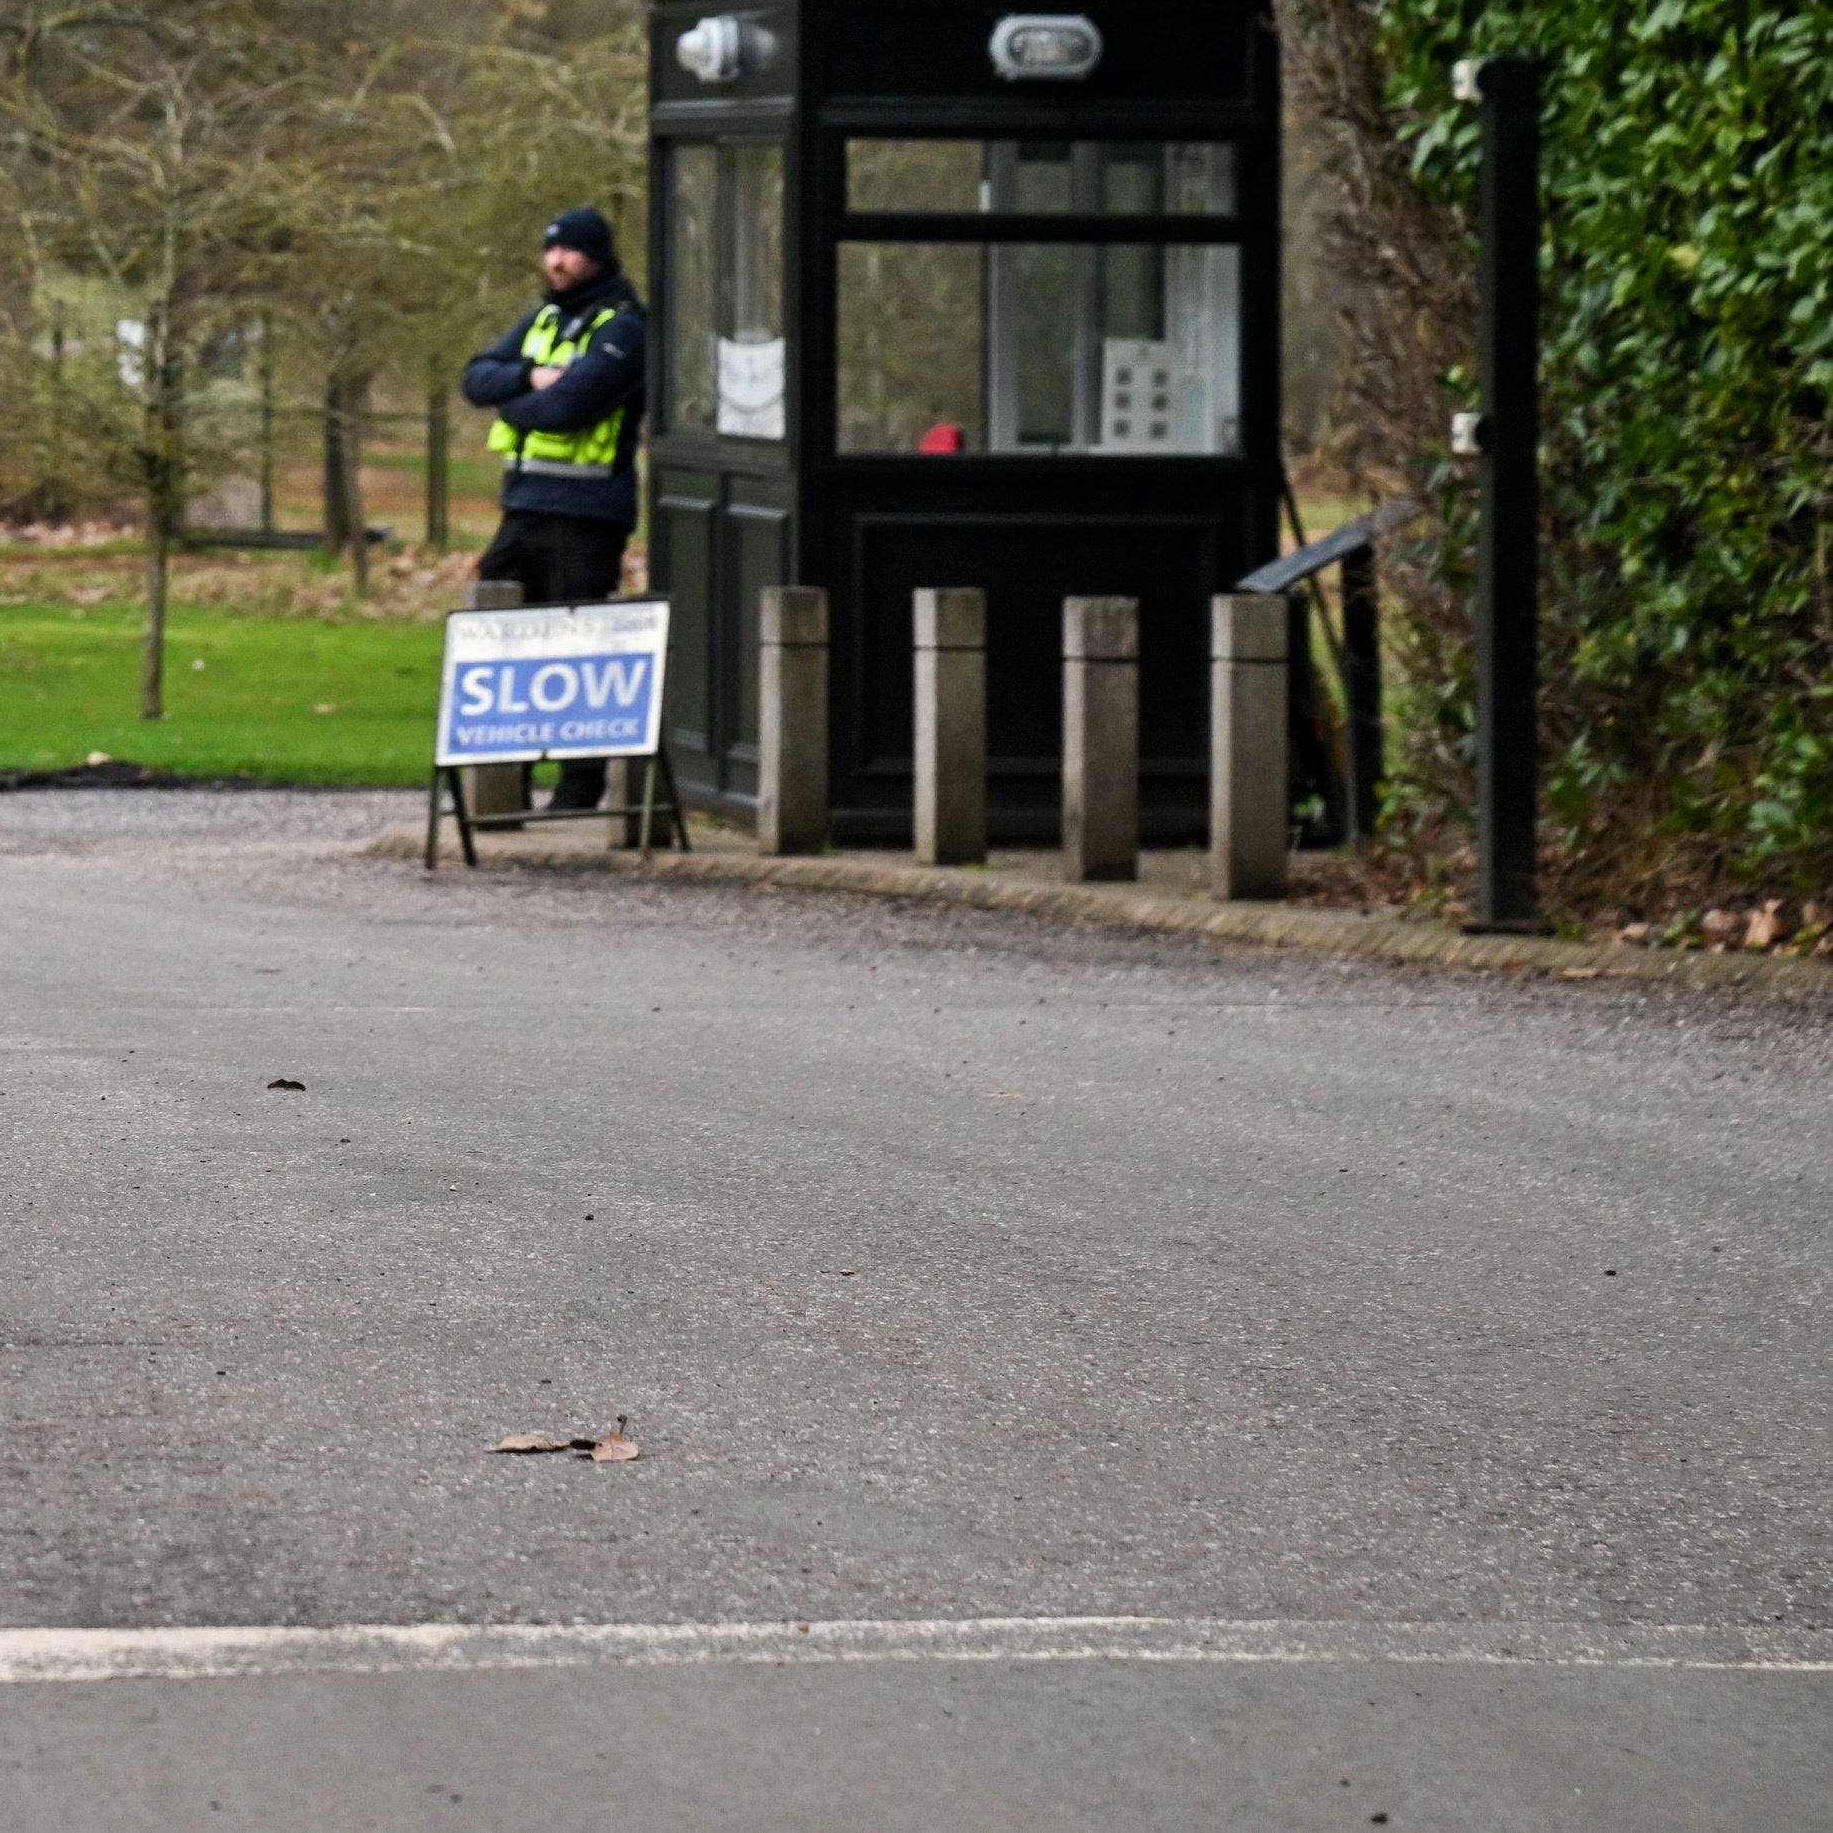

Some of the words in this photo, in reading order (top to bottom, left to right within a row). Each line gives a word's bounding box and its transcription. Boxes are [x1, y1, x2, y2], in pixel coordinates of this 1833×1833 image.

[460, 659, 648, 717] SLOW
[456, 721, 555, 746] VEHICLE
[559, 718, 640, 742] CHECK
